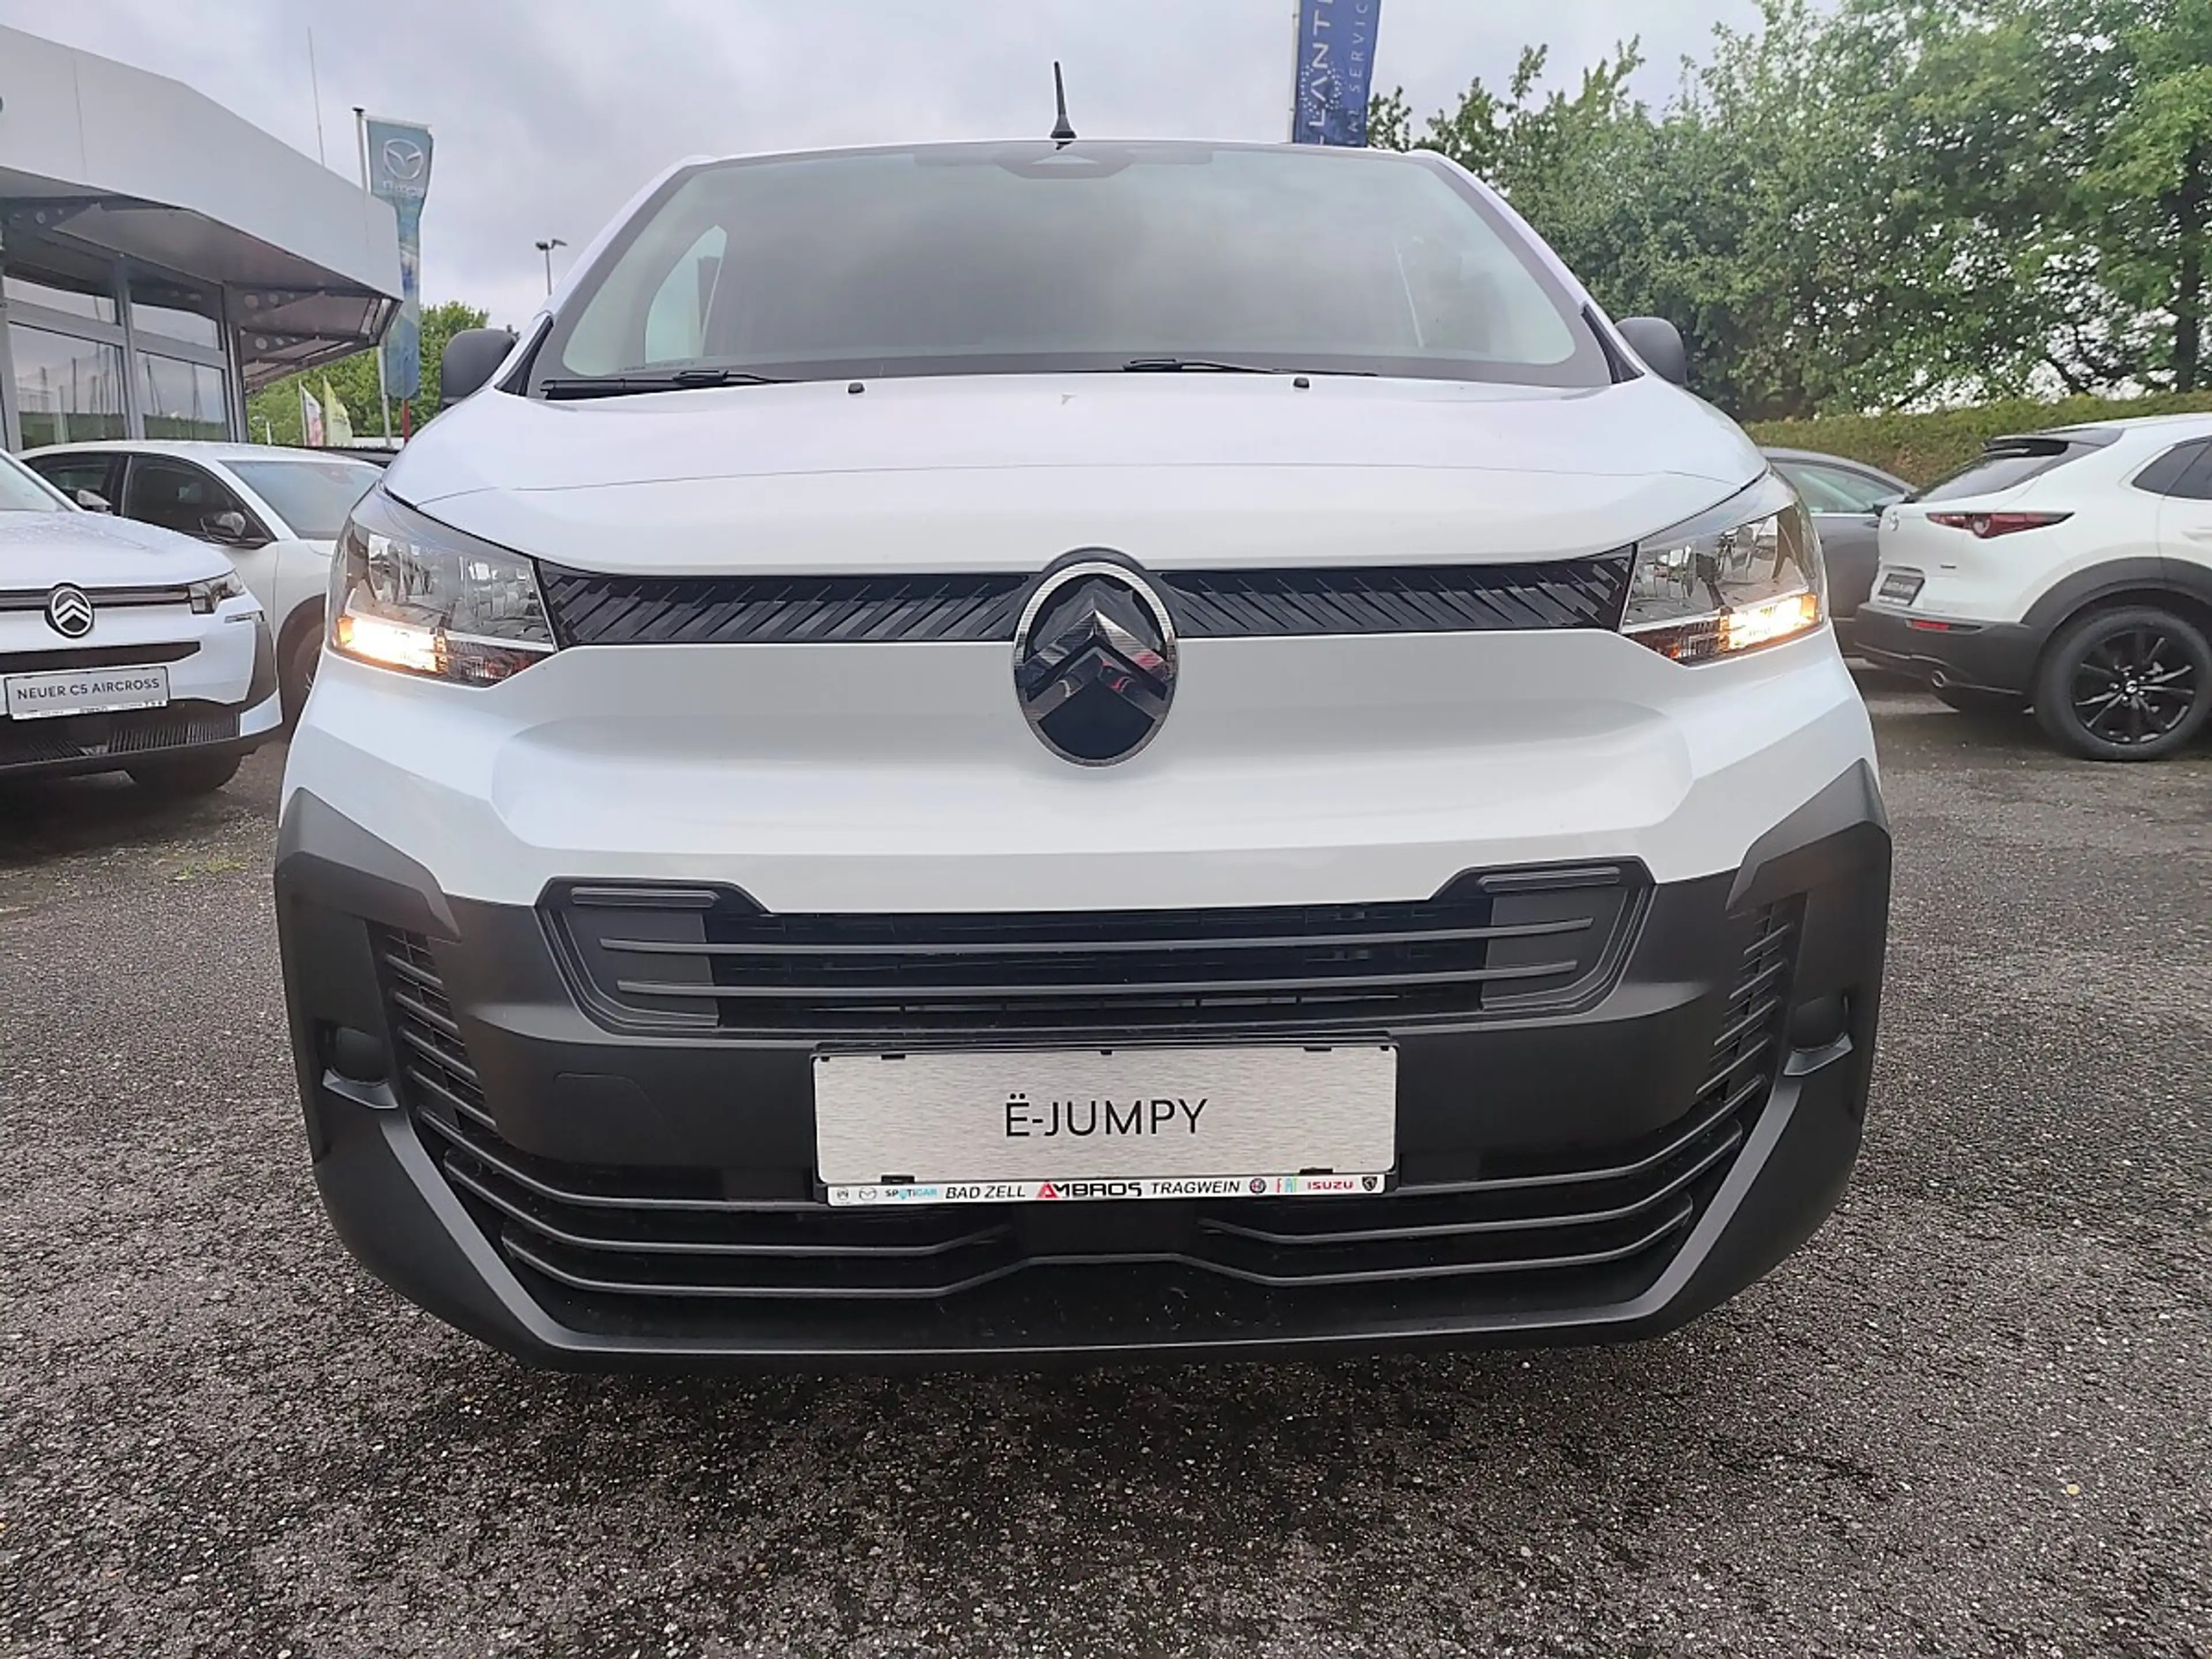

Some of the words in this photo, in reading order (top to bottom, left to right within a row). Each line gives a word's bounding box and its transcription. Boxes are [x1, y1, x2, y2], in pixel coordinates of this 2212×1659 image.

[17, 685, 66, 699] NEUER
[70, 684, 88, 696] C5
[92, 678, 160, 694] AIRCROSS
[1006, 1093, 1207, 1137] Ë-JUMPY
[945, 1187, 980, 1199] BAD
[984, 1185, 1026, 1198] ZELL
[1036, 1180, 1142, 1198] AMBROS
[1152, 1181, 1241, 1194] TRAGWEIN
[1308, 1181, 1354, 1190] ISUZU
